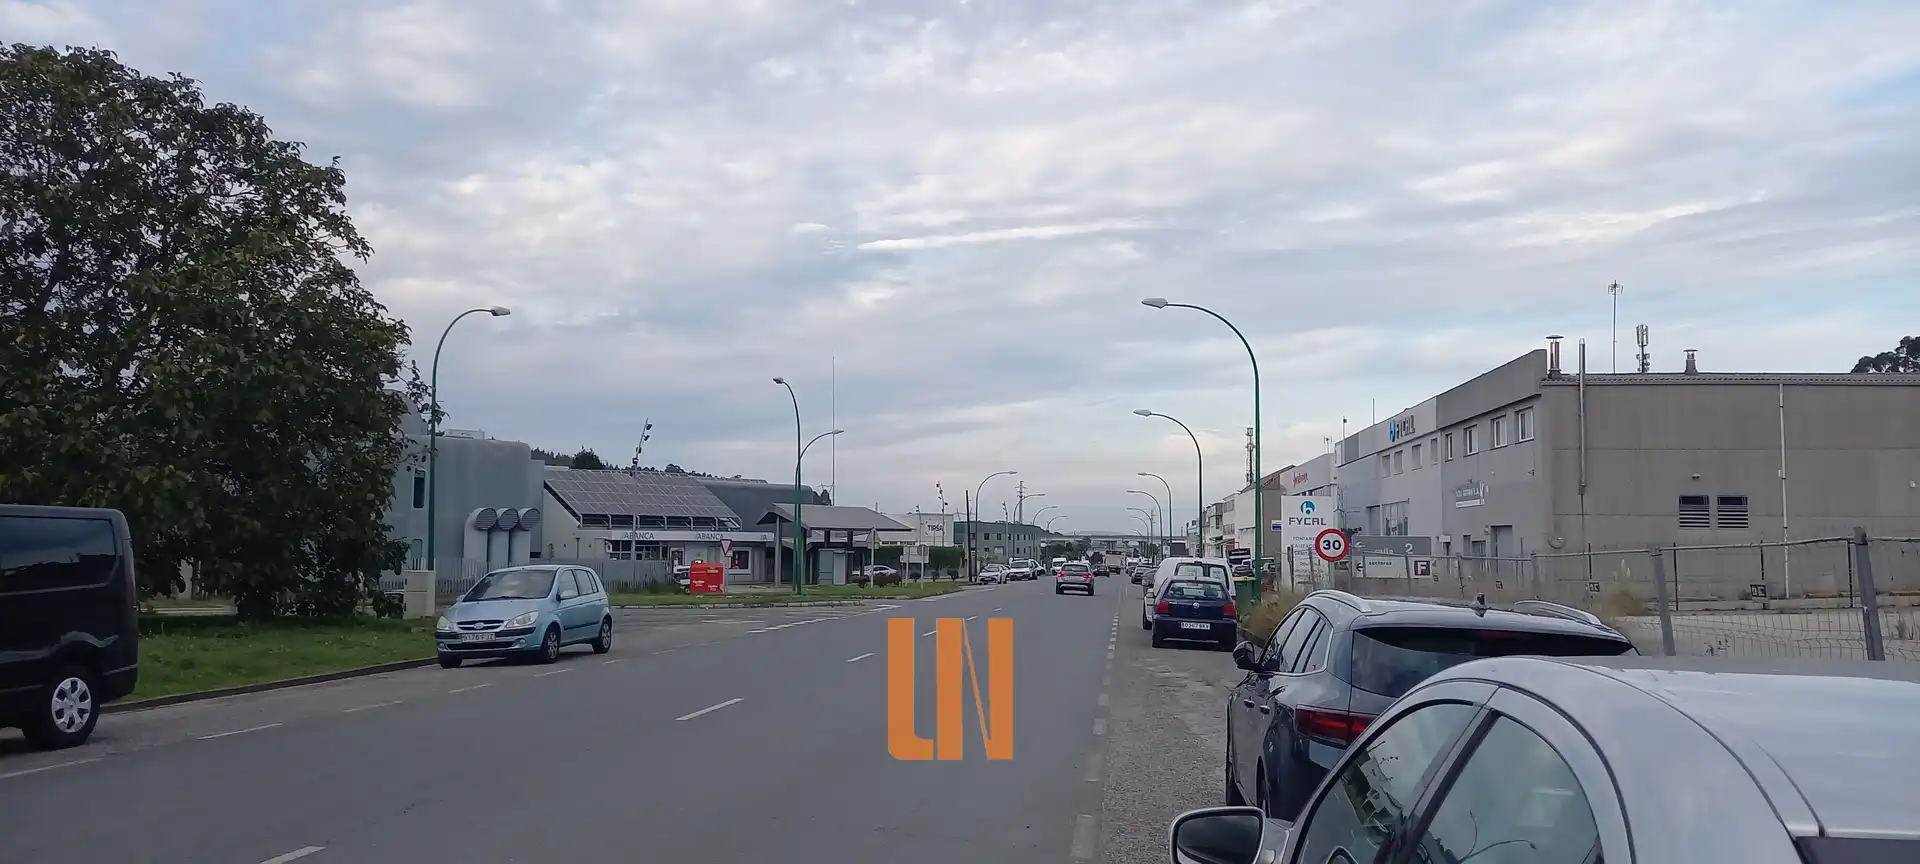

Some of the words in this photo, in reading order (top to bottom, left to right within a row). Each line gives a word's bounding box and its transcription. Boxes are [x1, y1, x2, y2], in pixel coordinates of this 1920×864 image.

[1289, 517, 1326, 526] FYCAL
[624, 532, 655, 540] ABANCA
[1322, 539, 1342, 551] 30
[1404, 543, 1413, 554] 2
[1417, 562, 1427, 575] F
